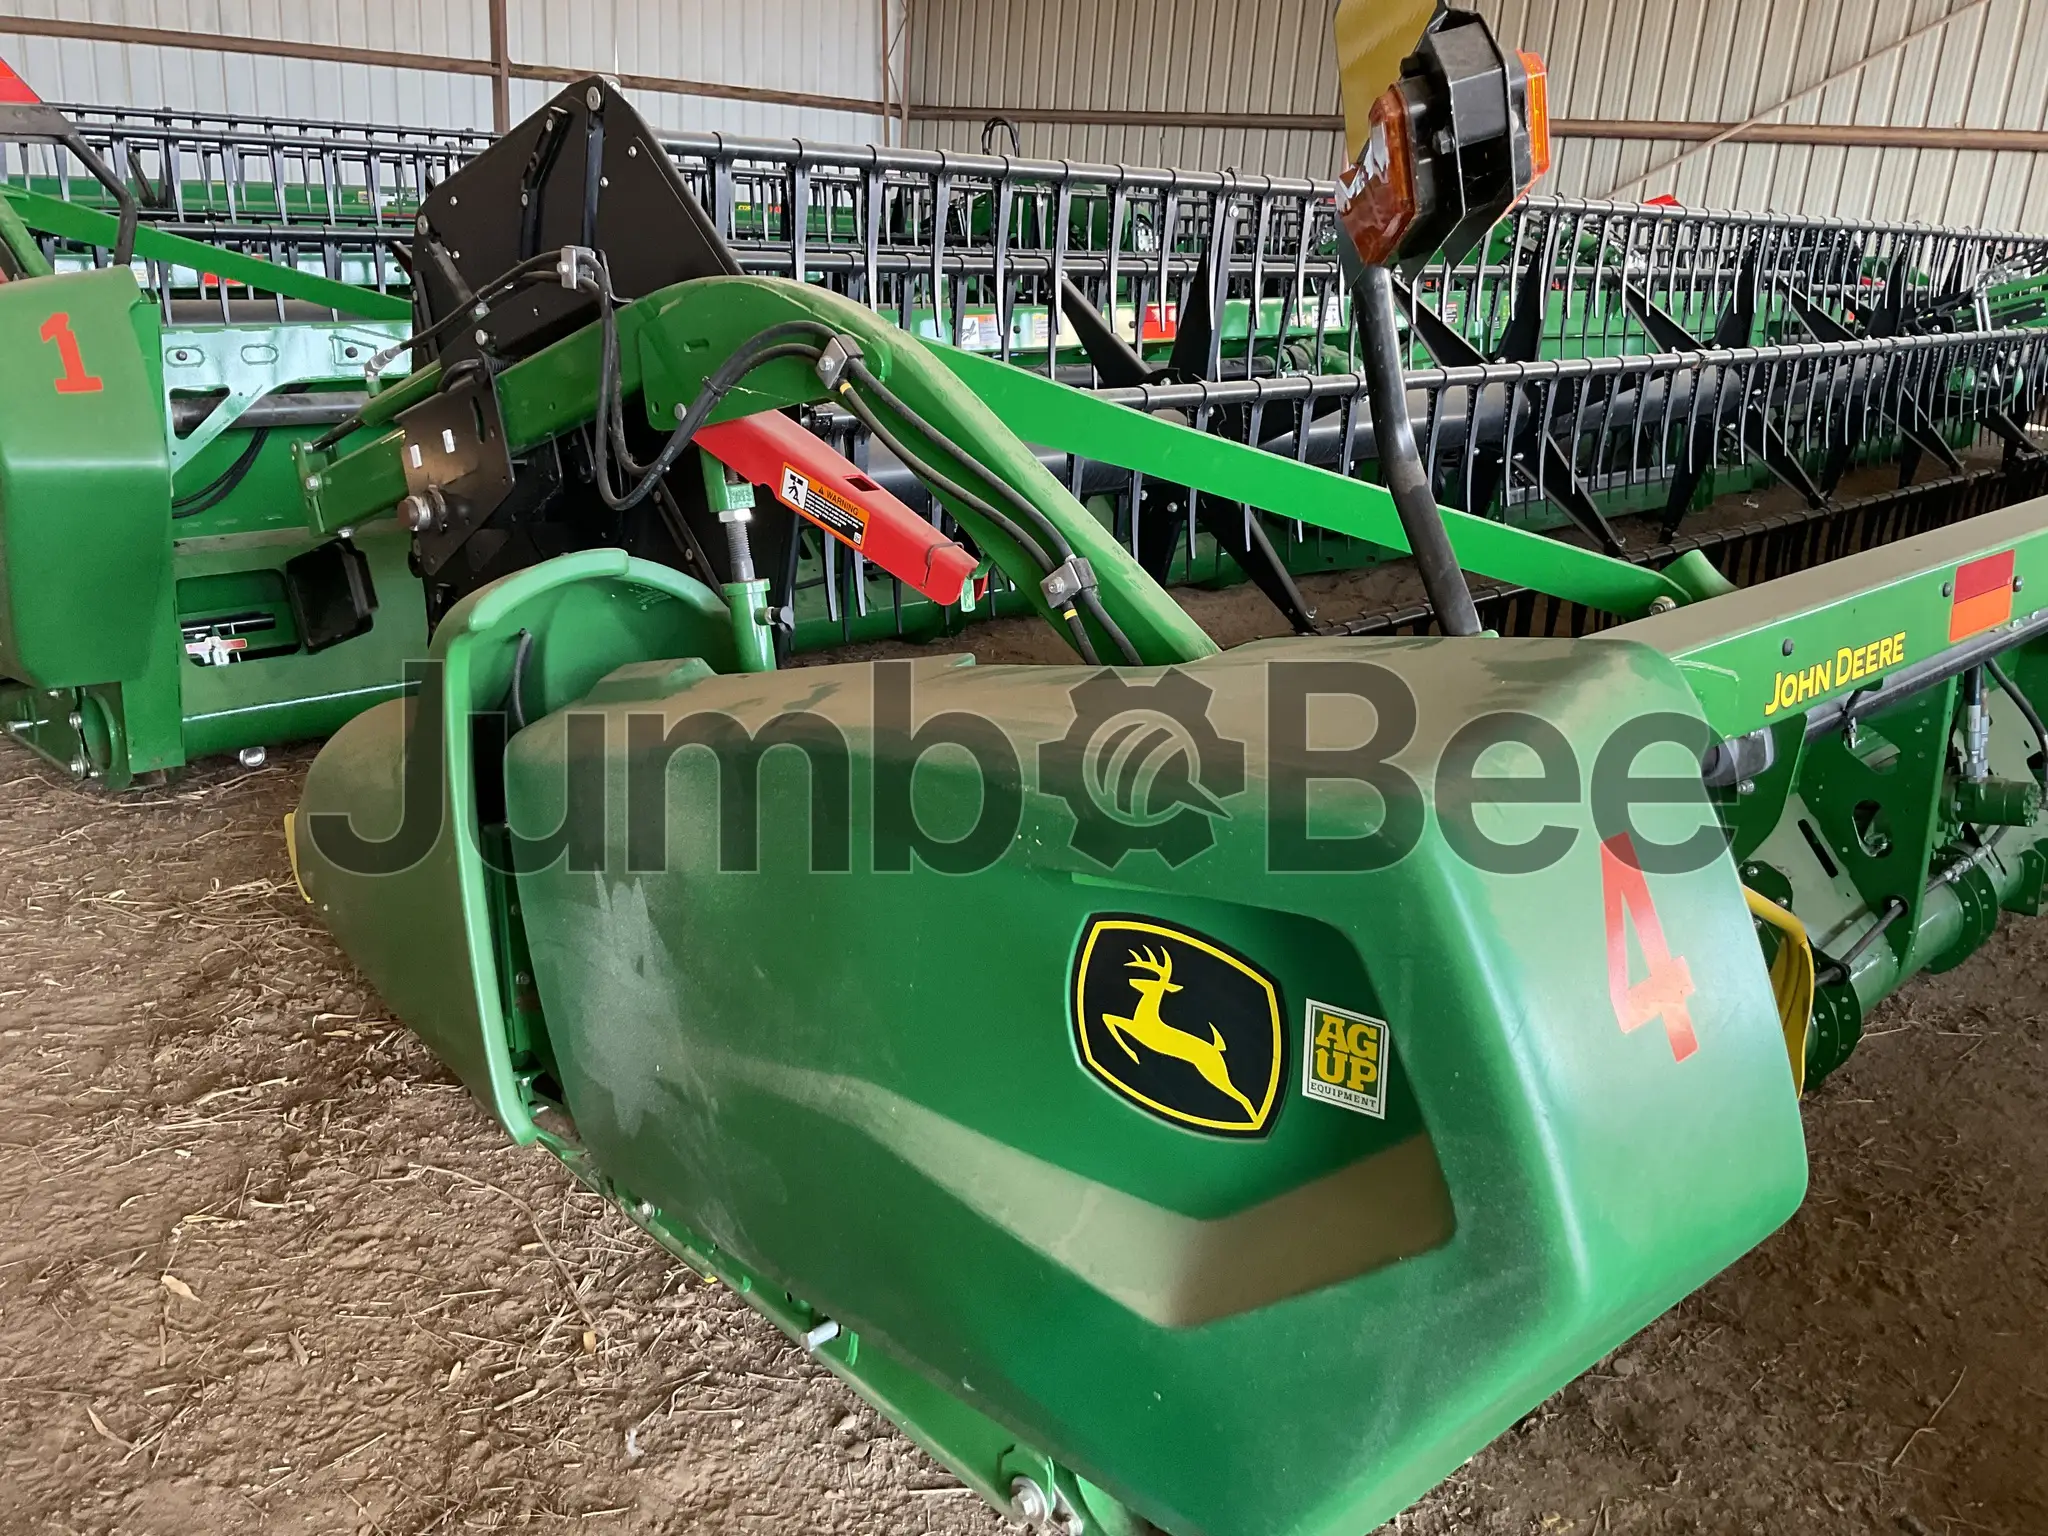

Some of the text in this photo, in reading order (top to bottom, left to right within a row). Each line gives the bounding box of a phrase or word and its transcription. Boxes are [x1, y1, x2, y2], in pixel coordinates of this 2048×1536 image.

[40, 312, 104, 393] 1
[827, 491, 858, 515] WARNING
[1764, 631, 1906, 716] JOHN DEERE
[1600, 831, 1699, 1064] 4
[1315, 1013, 1378, 1061] AG
[1316, 1048, 1378, 1092] UP
[1310, 1082, 1377, 1108] EQUIPMENT
